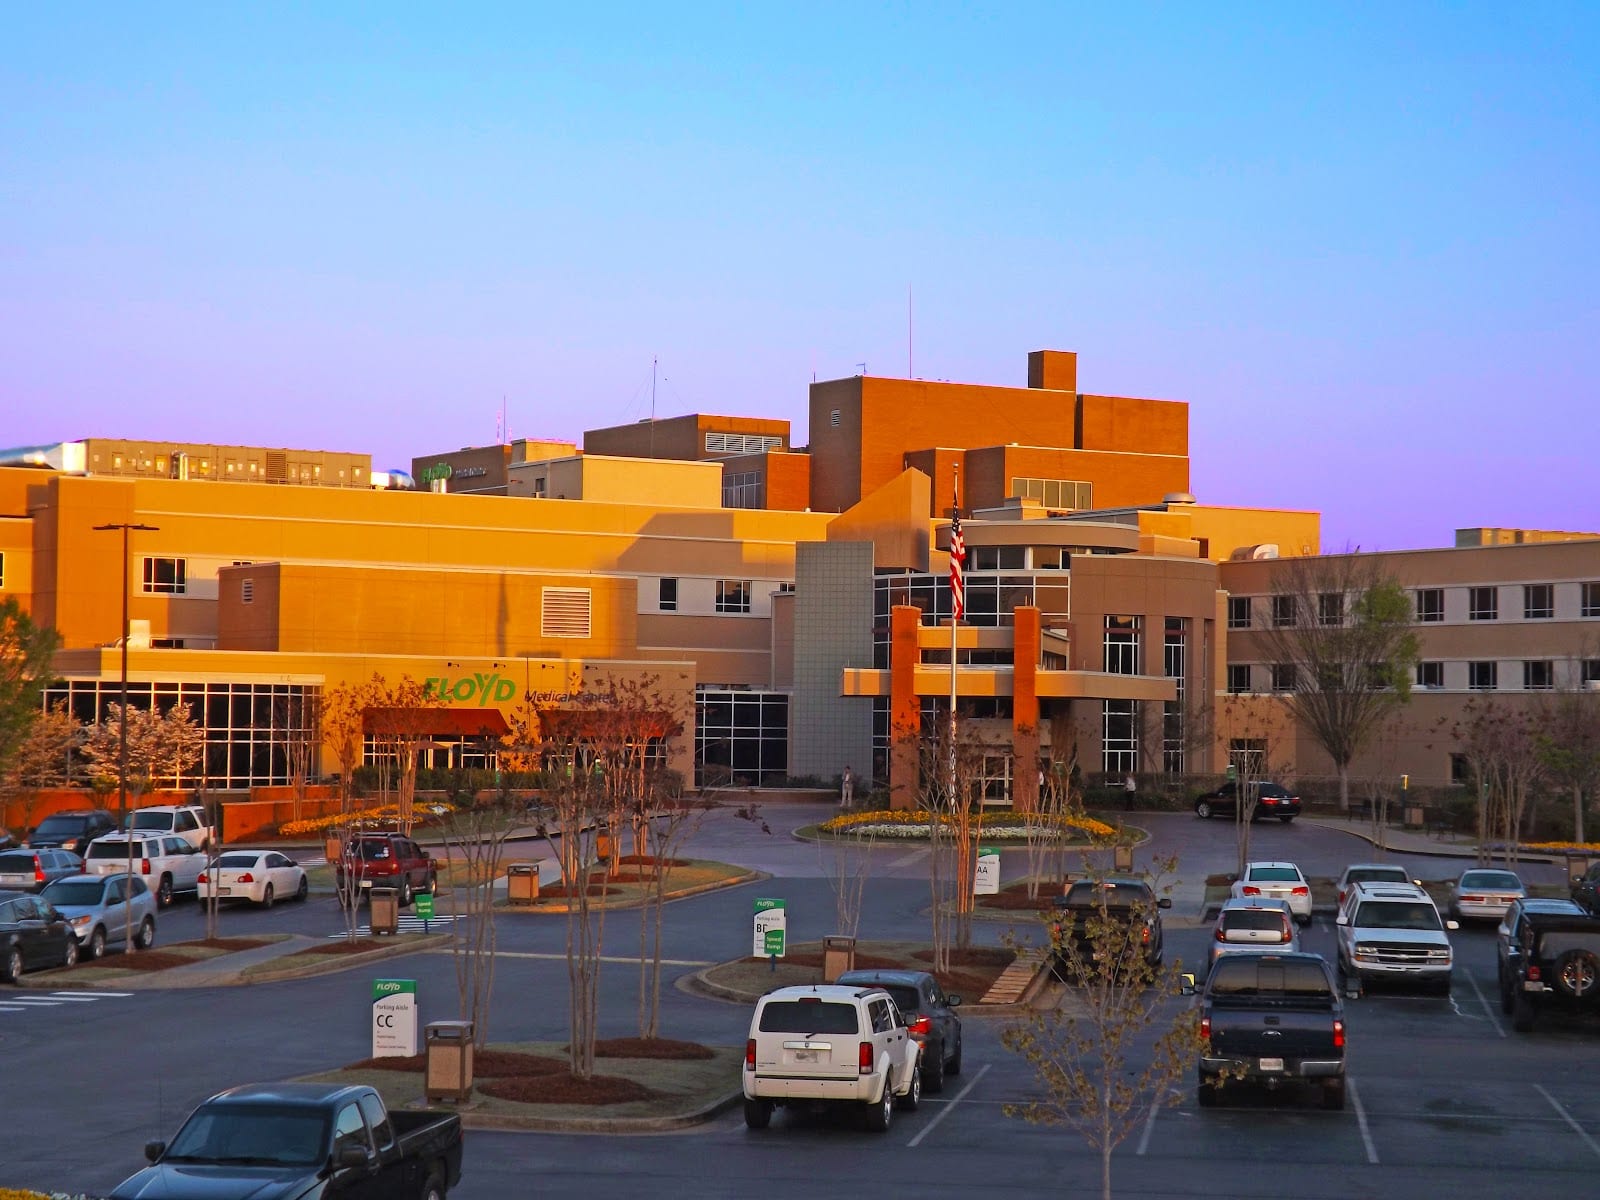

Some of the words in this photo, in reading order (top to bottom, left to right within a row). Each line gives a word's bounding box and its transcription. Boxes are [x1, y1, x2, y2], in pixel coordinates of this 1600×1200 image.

[423, 672, 516, 706] FLOYD
[525, 690, 570, 703] Medical
[376, 982, 401, 992] FLOYD
[376, 1014, 393, 1028] CC
